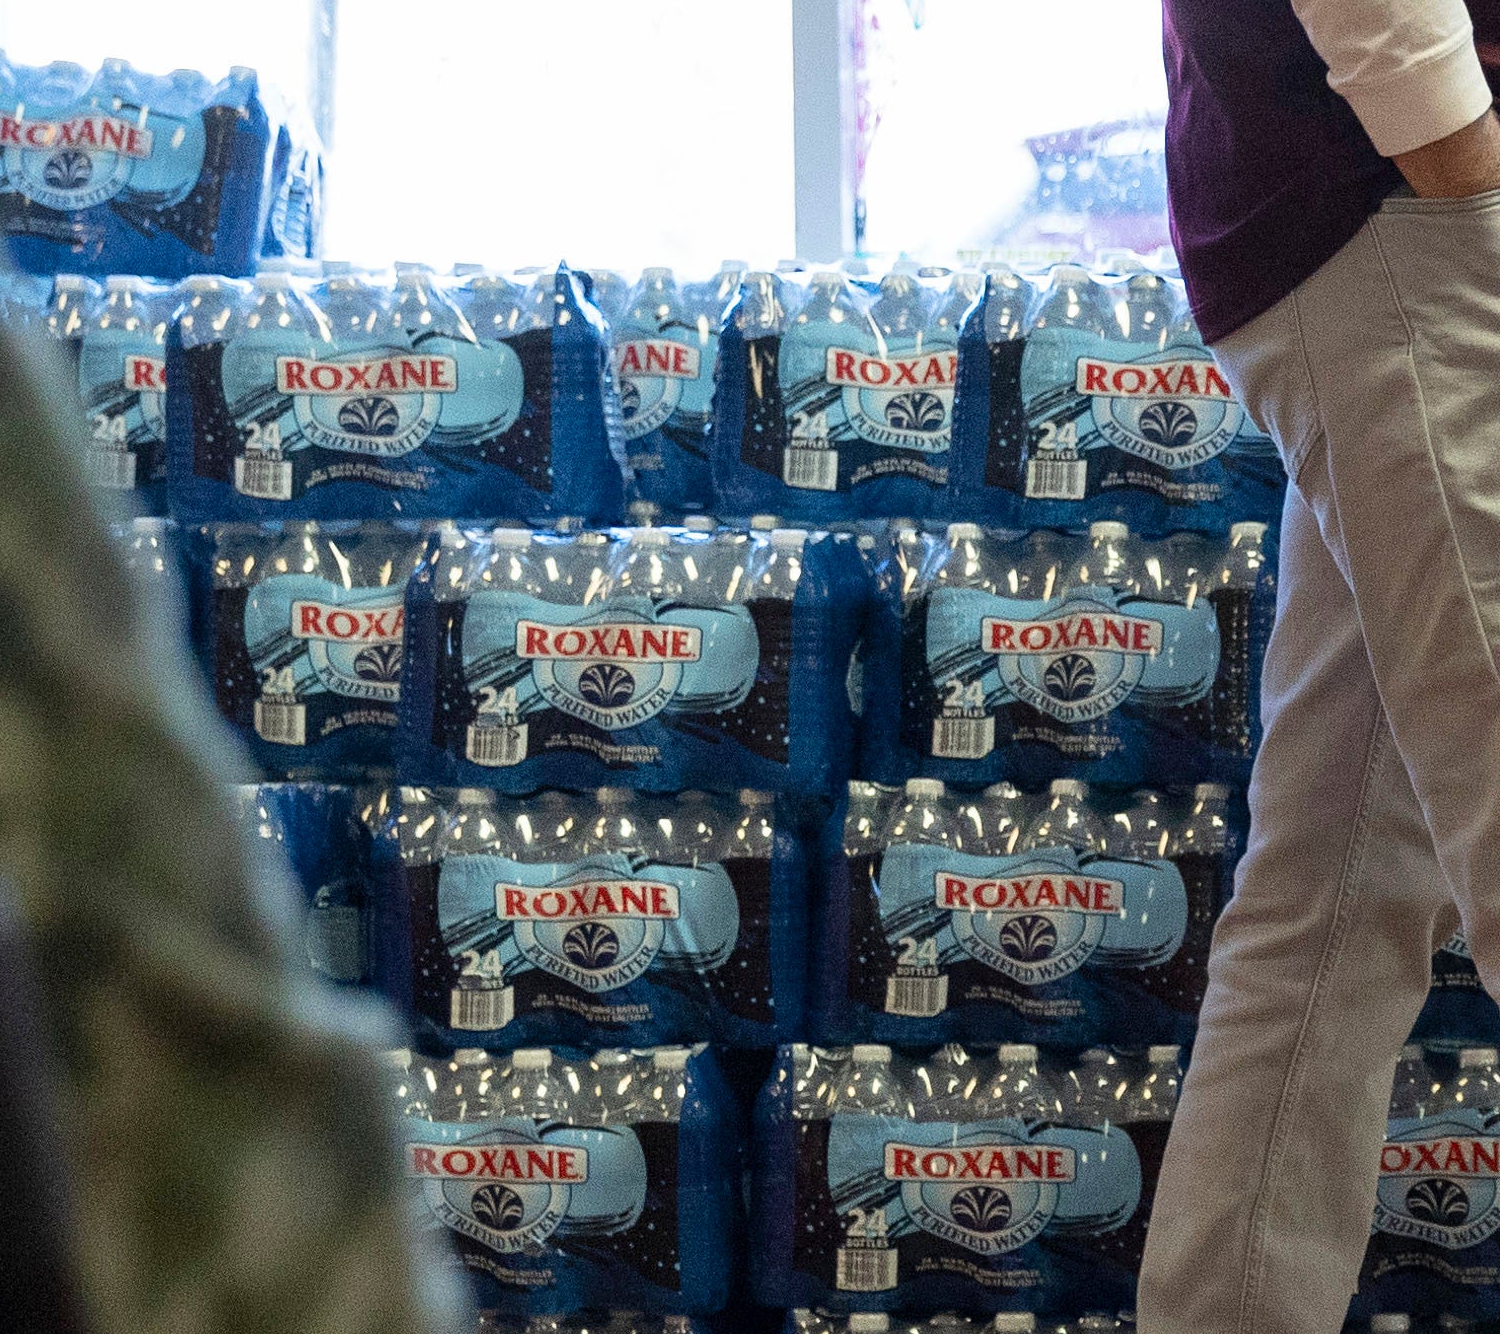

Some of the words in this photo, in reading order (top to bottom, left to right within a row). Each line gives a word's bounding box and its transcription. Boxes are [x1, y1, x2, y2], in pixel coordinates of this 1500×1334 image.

[0, 117, 145, 156] ROXANE
[621, 343, 691, 375] ANE
[834, 351, 957, 386] ROXA
[286, 359, 446, 392] ROXANE
[1085, 364, 1230, 396] ROXAN
[245, 422, 281, 448] 24
[791, 412, 828, 437] 24
[1038, 423, 1076, 448] 24
[1179, 428, 1231, 466] WATER
[525, 626, 691, 658] ROXANE
[991, 617, 1151, 651] ROXANE
[262, 667, 295, 693] 24
[945, 681, 984, 707] 24
[480, 687, 518, 714] 24
[617, 689, 669, 727] WATER
[1077, 678, 1131, 720] WATER
[504, 885, 673, 917] ROXANE
[945, 877, 1117, 911] ROXANE
[459, 951, 503, 977] 24
[602, 944, 655, 987] WATER
[899, 937, 937, 966] 24
[1037, 942, 1092, 980] WATER
[412, 1146, 582, 1180] ROXANE
[893, 1148, 1068, 1180] ROXANE
[848, 1210, 887, 1237] 24
[992, 1209, 1047, 1251] WATER
